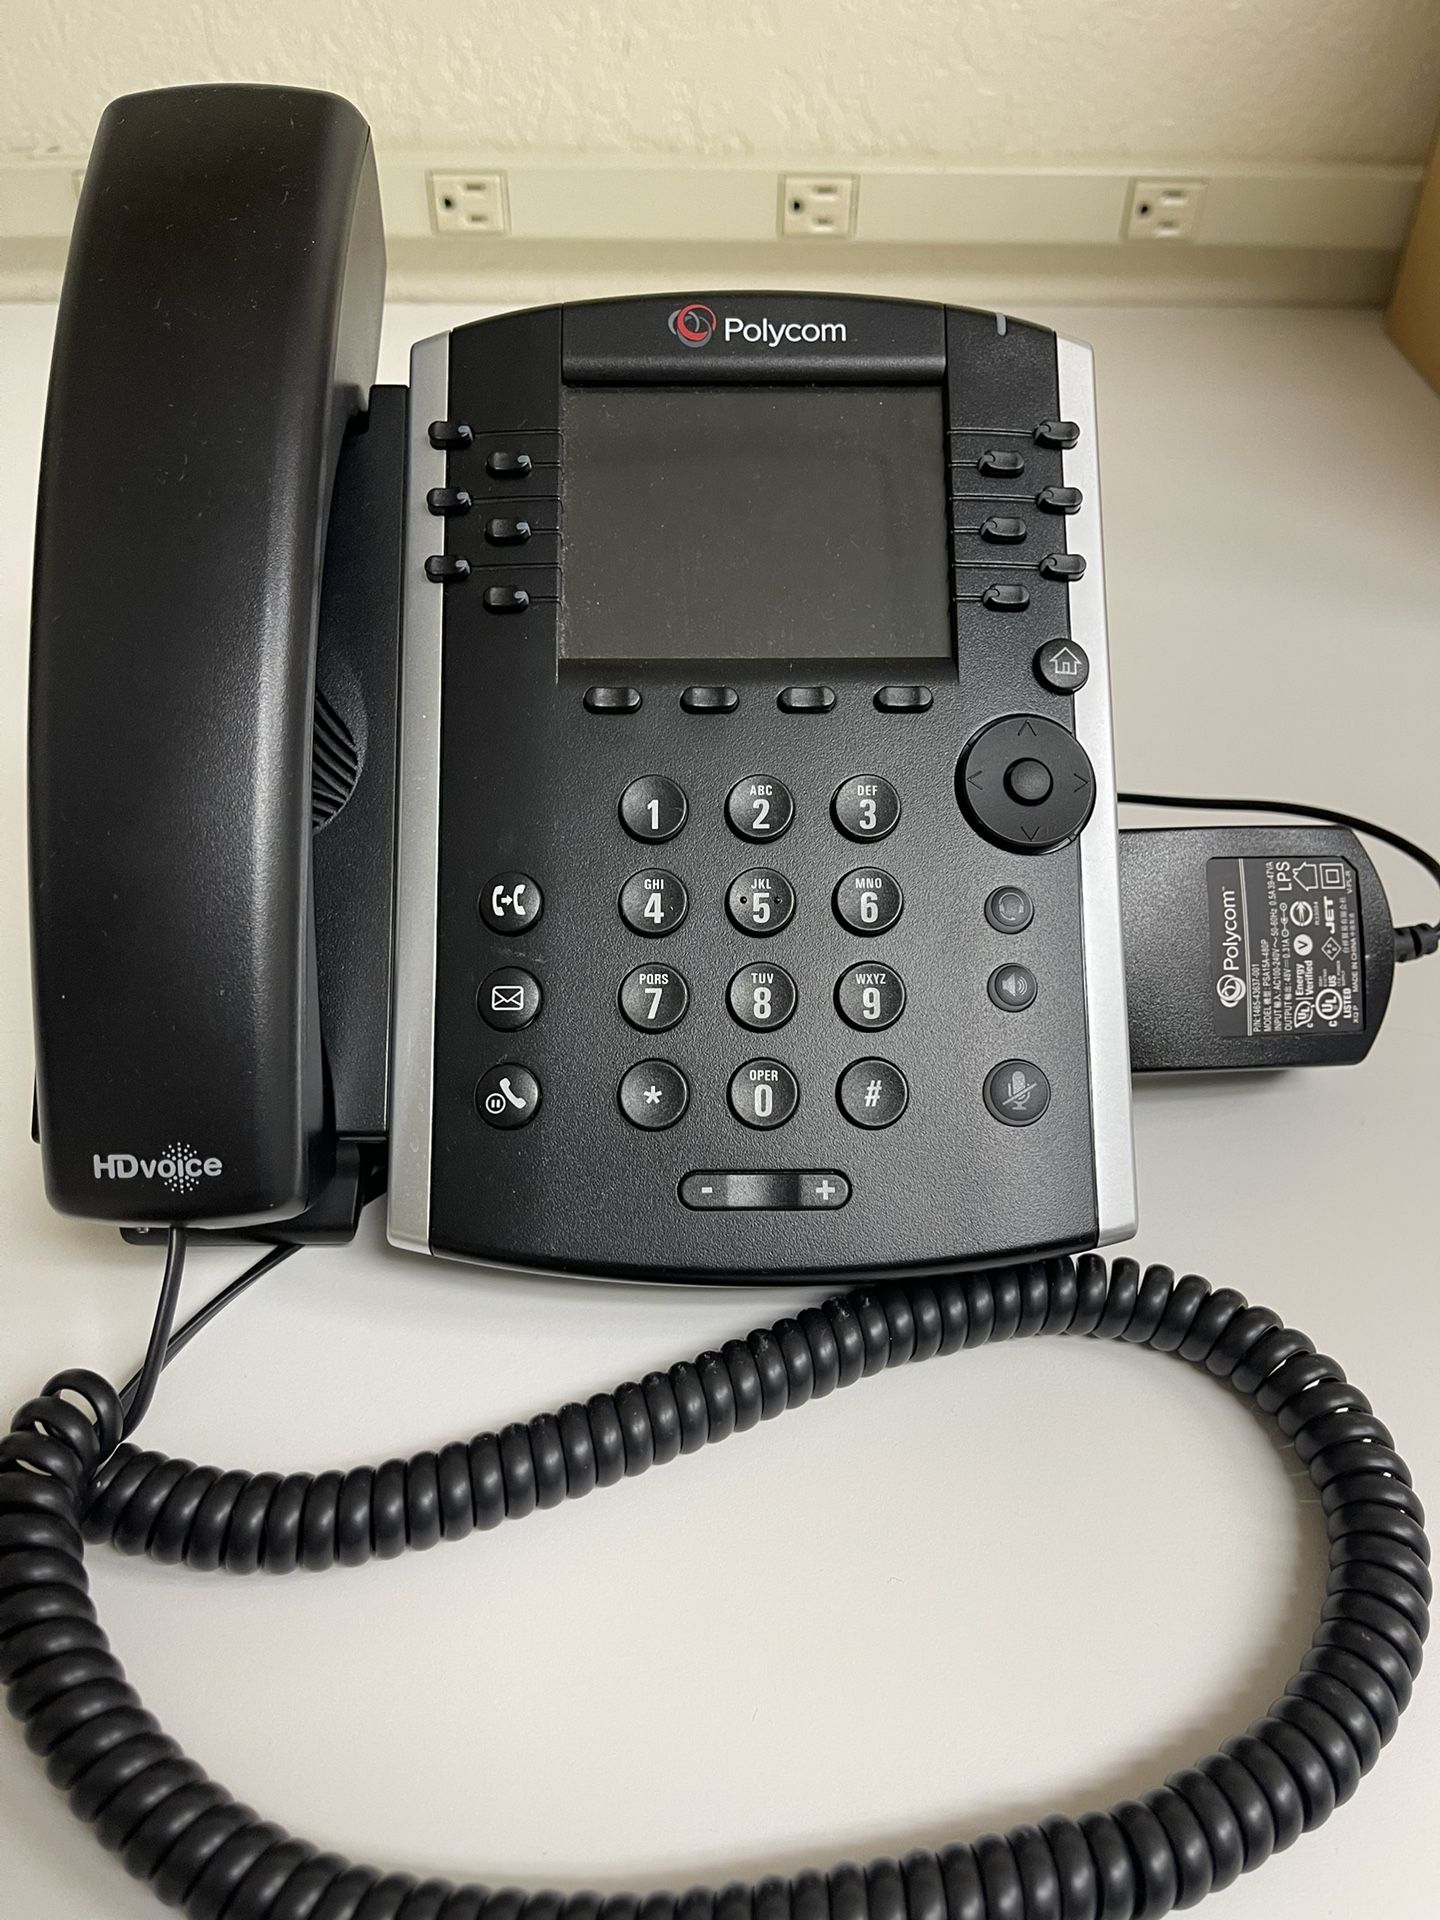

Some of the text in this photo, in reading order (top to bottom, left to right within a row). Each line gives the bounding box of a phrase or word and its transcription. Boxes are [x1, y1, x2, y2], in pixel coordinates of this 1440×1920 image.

[725, 318, 847, 347] Polycom
[750, 784, 773, 796] ABC
[857, 784, 878, 796] DEF
[647, 799, 659, 830] 1
[752, 798, 770, 829] 2
[859, 799, 877, 830] 3
[644, 879, 664, 890] GHI
[751, 879, 772, 890] JKL
[855, 878, 882, 889] MNO
[1277, 861, 1292, 891] LPS
[644, 892, 664, 923] 4
[752, 892, 771, 923] 5
[860, 891, 879, 923] 6
[1323, 896, 1335, 934] JET
[639, 973, 669, 985] PQRS
[751, 973, 774, 984] TUV
[855, 973, 886, 985] WXYZ
[1295, 963, 1305, 995] Energy
[1304, 960, 1313, 995] Verified
[1352, 961, 1358, 969] IN
[1328, 975, 1336, 987] US
[644, 988, 663, 1019] 7
[753, 987, 772, 1019] 8
[862, 987, 881, 1019] 9
[1284, 1001, 1293, 1031] OUTPUT
[1322, 996, 1336, 1013] UL
[1343, 988, 1351, 1018] LISTED
[1263, 1006, 1272, 1031] MODEL
[1274, 1009, 1282, 1031] INPUT
[749, 1070, 779, 1081] OPER
[754, 1084, 773, 1117] 0
[865, 1079, 882, 1107] #
